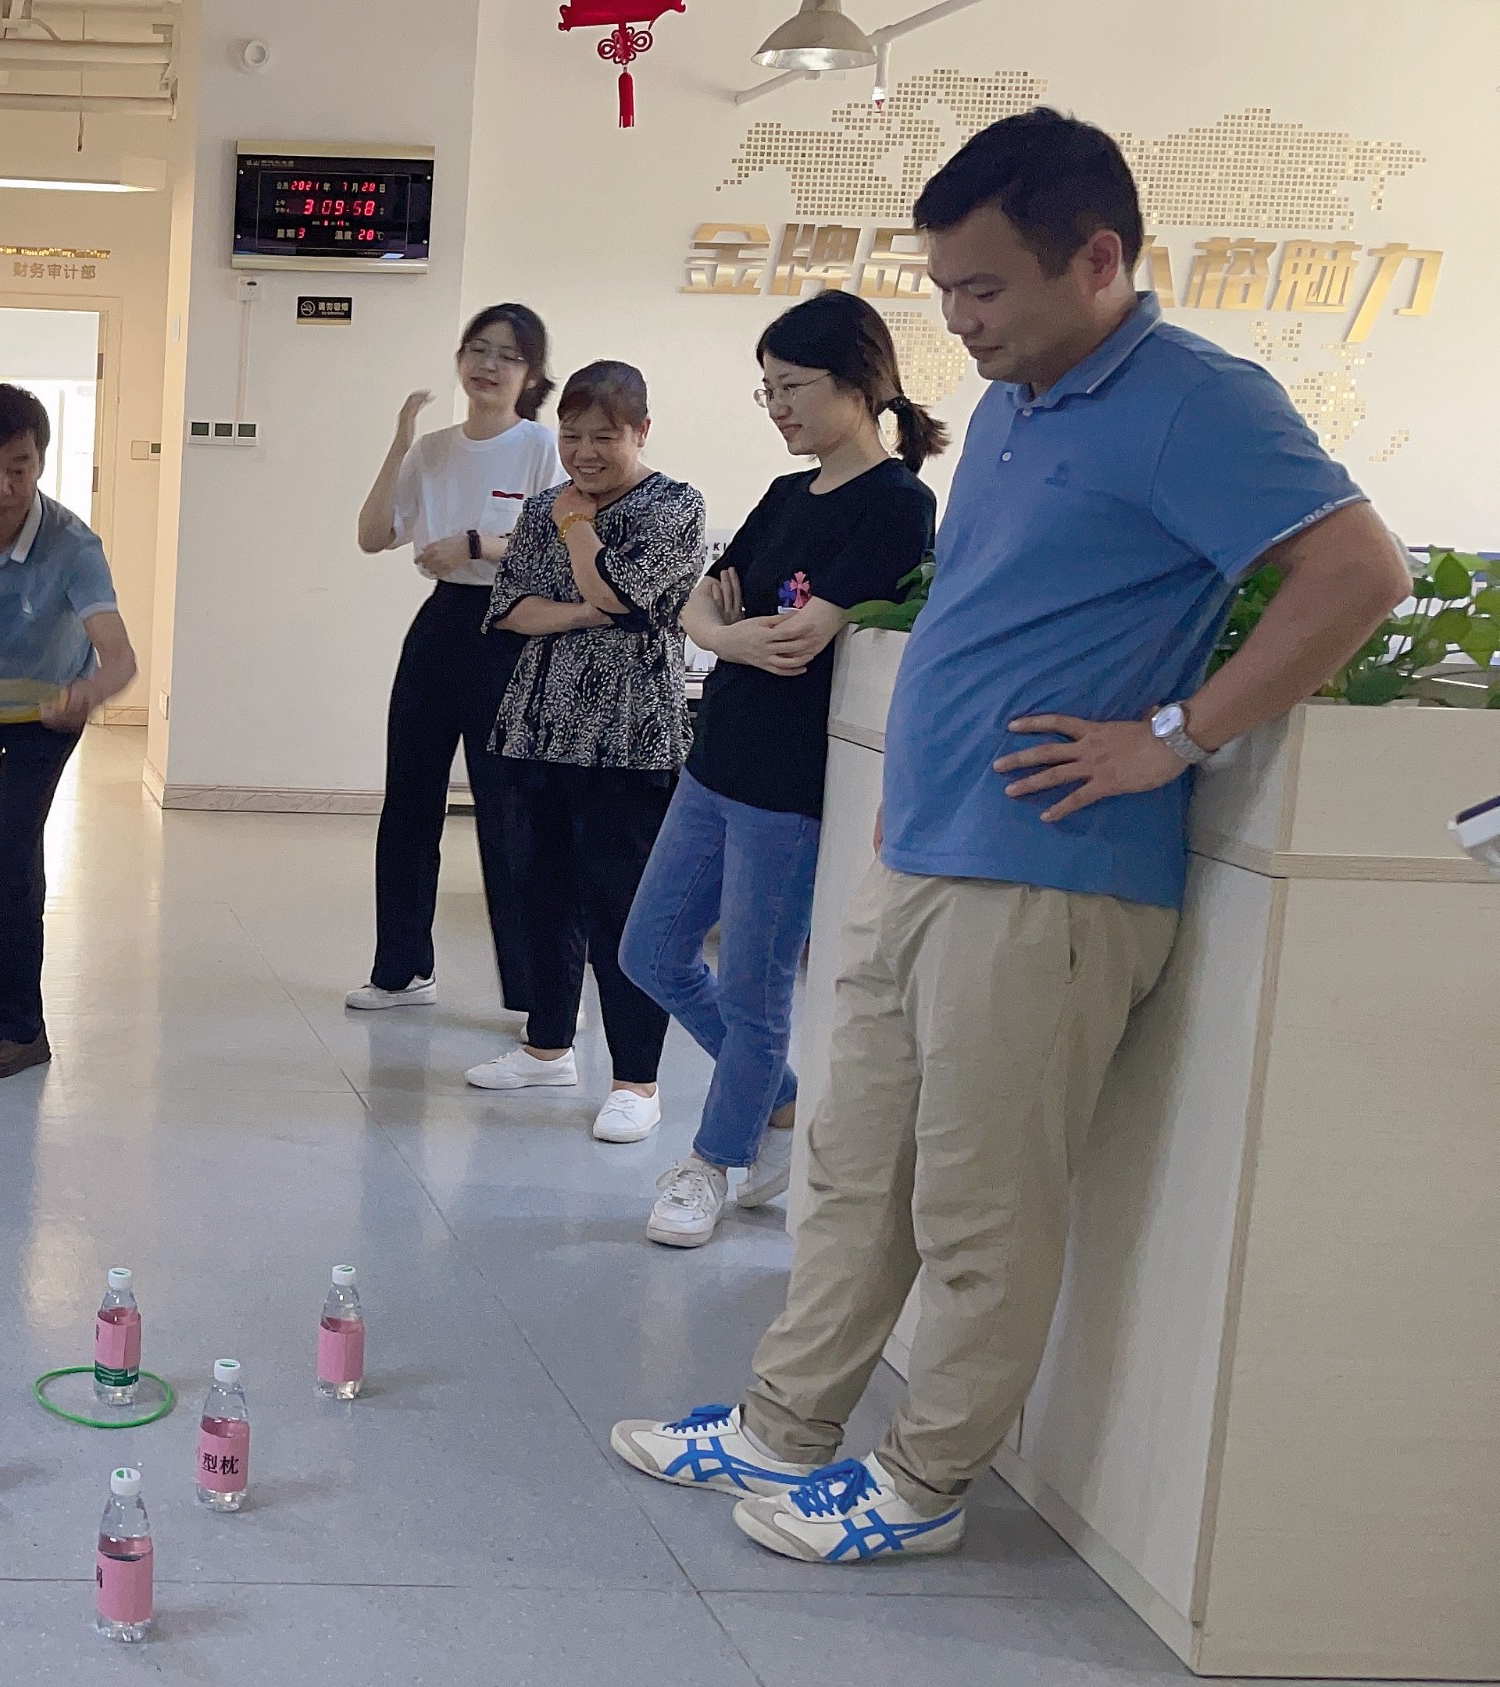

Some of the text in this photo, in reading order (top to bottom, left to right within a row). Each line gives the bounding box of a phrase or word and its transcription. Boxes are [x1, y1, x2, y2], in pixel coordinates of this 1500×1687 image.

[291, 180, 320, 191] 2021
[12, 261, 96, 280] 财务审计部
[202, 1453, 239, 1475] 型枕
